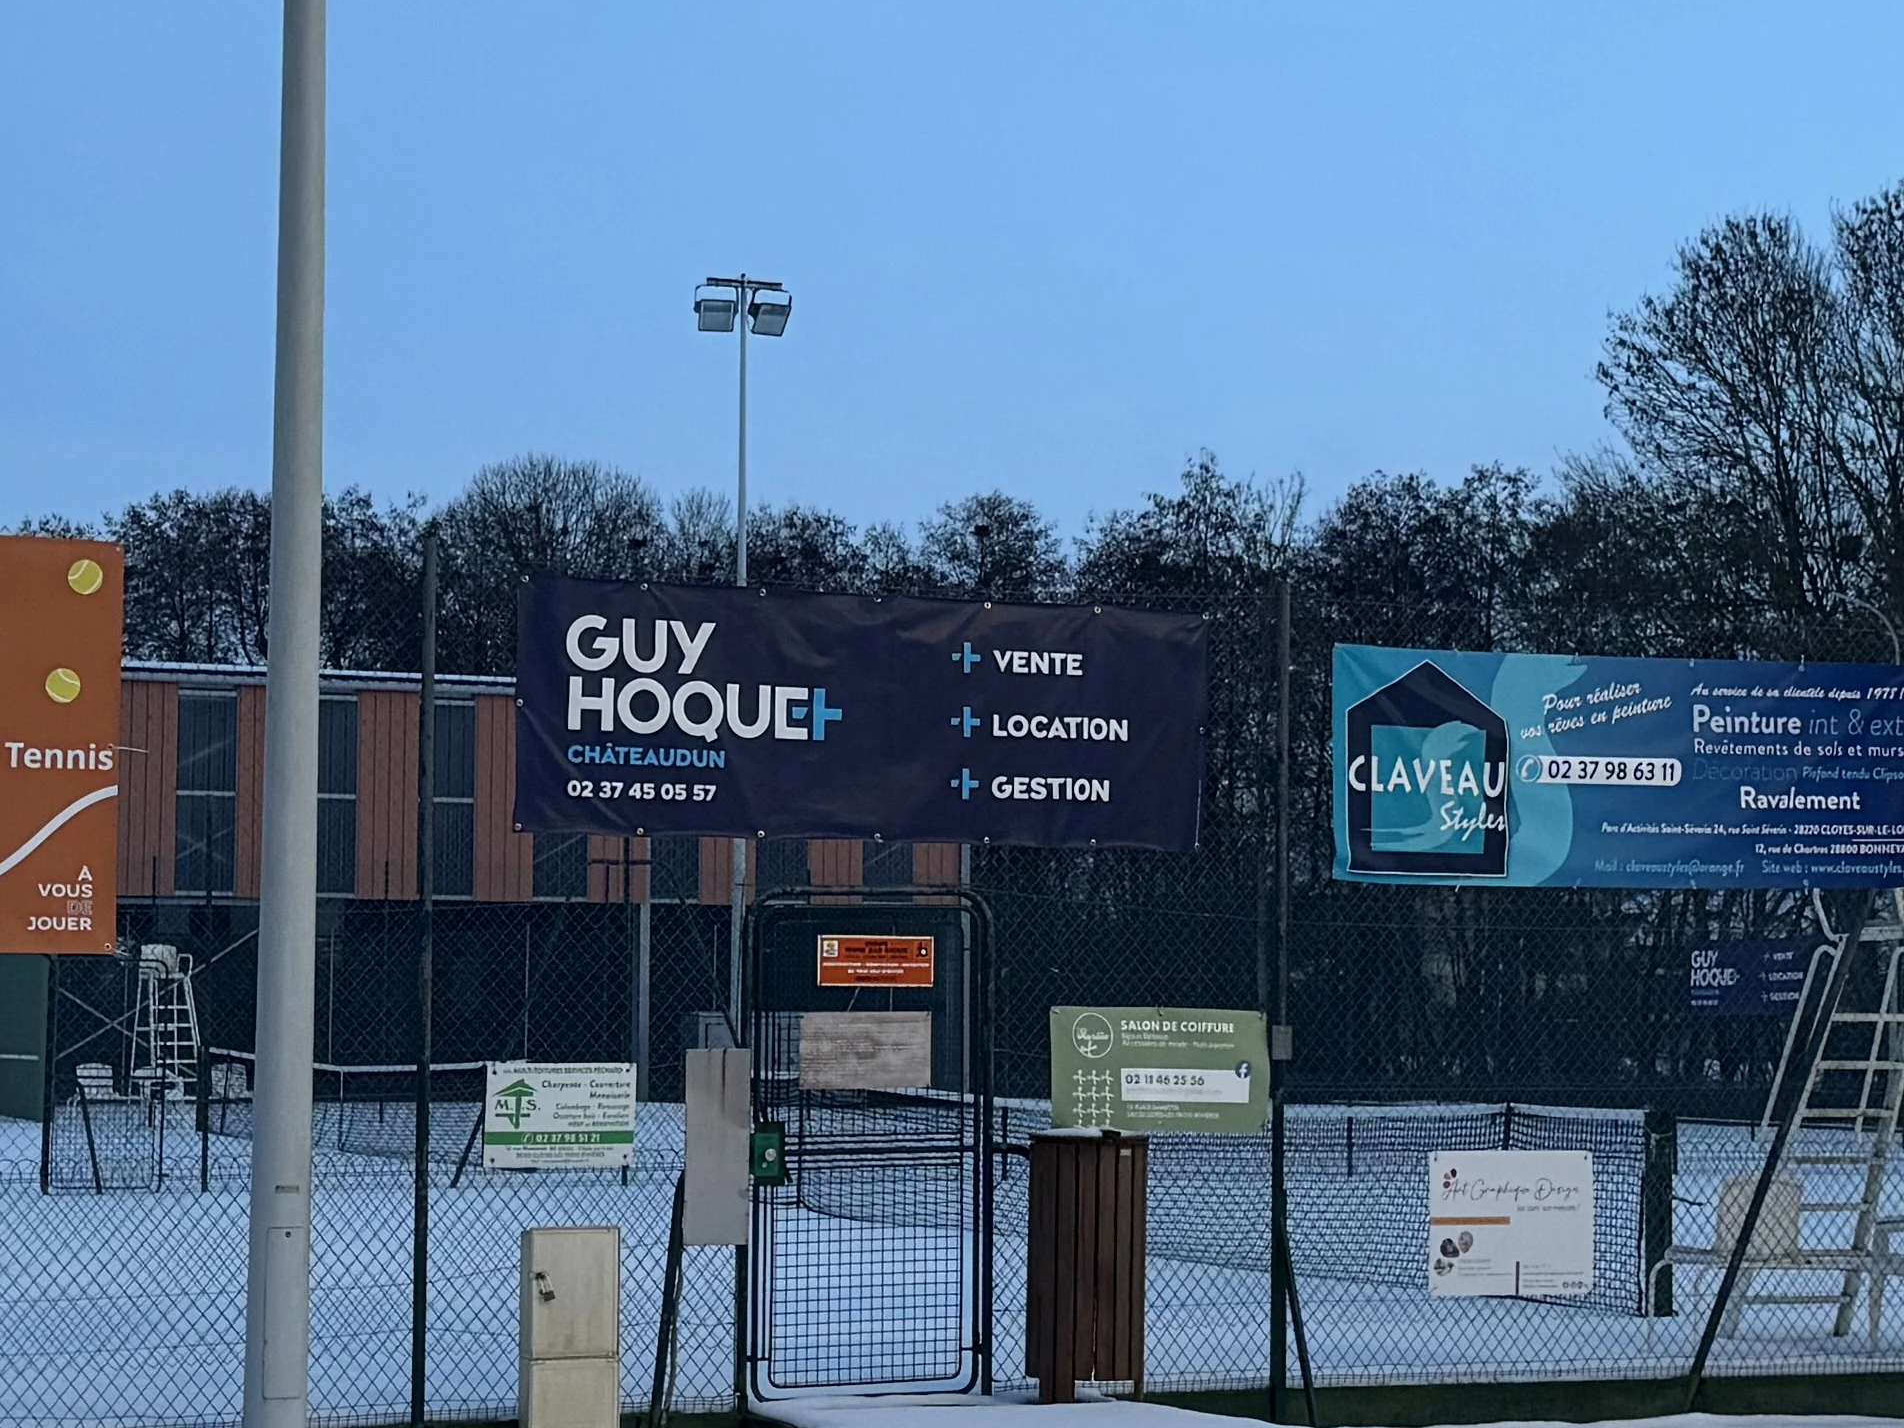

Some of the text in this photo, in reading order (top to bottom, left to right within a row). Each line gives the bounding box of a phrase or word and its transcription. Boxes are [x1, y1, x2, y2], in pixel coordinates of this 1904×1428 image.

[566, 614, 717, 674] GUY
[993, 650, 1083, 675] VENTE
[1542, 682, 1642, 715] Pour réaliser
[1690, 683, 1709, 696] Au
[1750, 685, 1764, 697] de
[1828, 687, 1861, 701] depuis
[993, 714, 1128, 742] LOCATION
[1520, 725, 1543, 739] vos
[1591, 710, 1608, 724] en
[1611, 696, 1672, 724] peinture
[1692, 704, 1904, 736] Peinture int & ext
[5, 742, 114, 772] Tennis
[567, 742, 726, 768] CHÂTEAUDUN
[1694, 738, 1904, 757] Revêtements de sols et murs
[1348, 755, 1505, 798] CLAVEAU
[1548, 760, 1675, 782] 02 37 98 63 11
[1842, 767, 1870, 780] tendu
[567, 780, 717, 801] 02 37 45 05 57
[991, 776, 1110, 802] GESTION
[1740, 786, 1861, 810] Ravalement
[1440, 800, 1505, 842] Styles
[1782, 843, 1792, 854] de
[1783, 860, 1803, 873] web
[38, 884, 93, 898] VOUS
[67, 900, 93, 915] DE
[27, 917, 93, 931] JOUER
[1691, 950, 1720, 968] GUY
[1120, 1020, 1235, 1034] SALON DE COIFFURE
[1125, 1074, 1140, 1084] 02
[1173, 1075, 1187, 1085] 25
[1190, 1076, 1205, 1086] 56
[536, 1133, 548, 1143] 02
[551, 1133, 562, 1143] 37
[590, 1133, 601, 1143] 21
